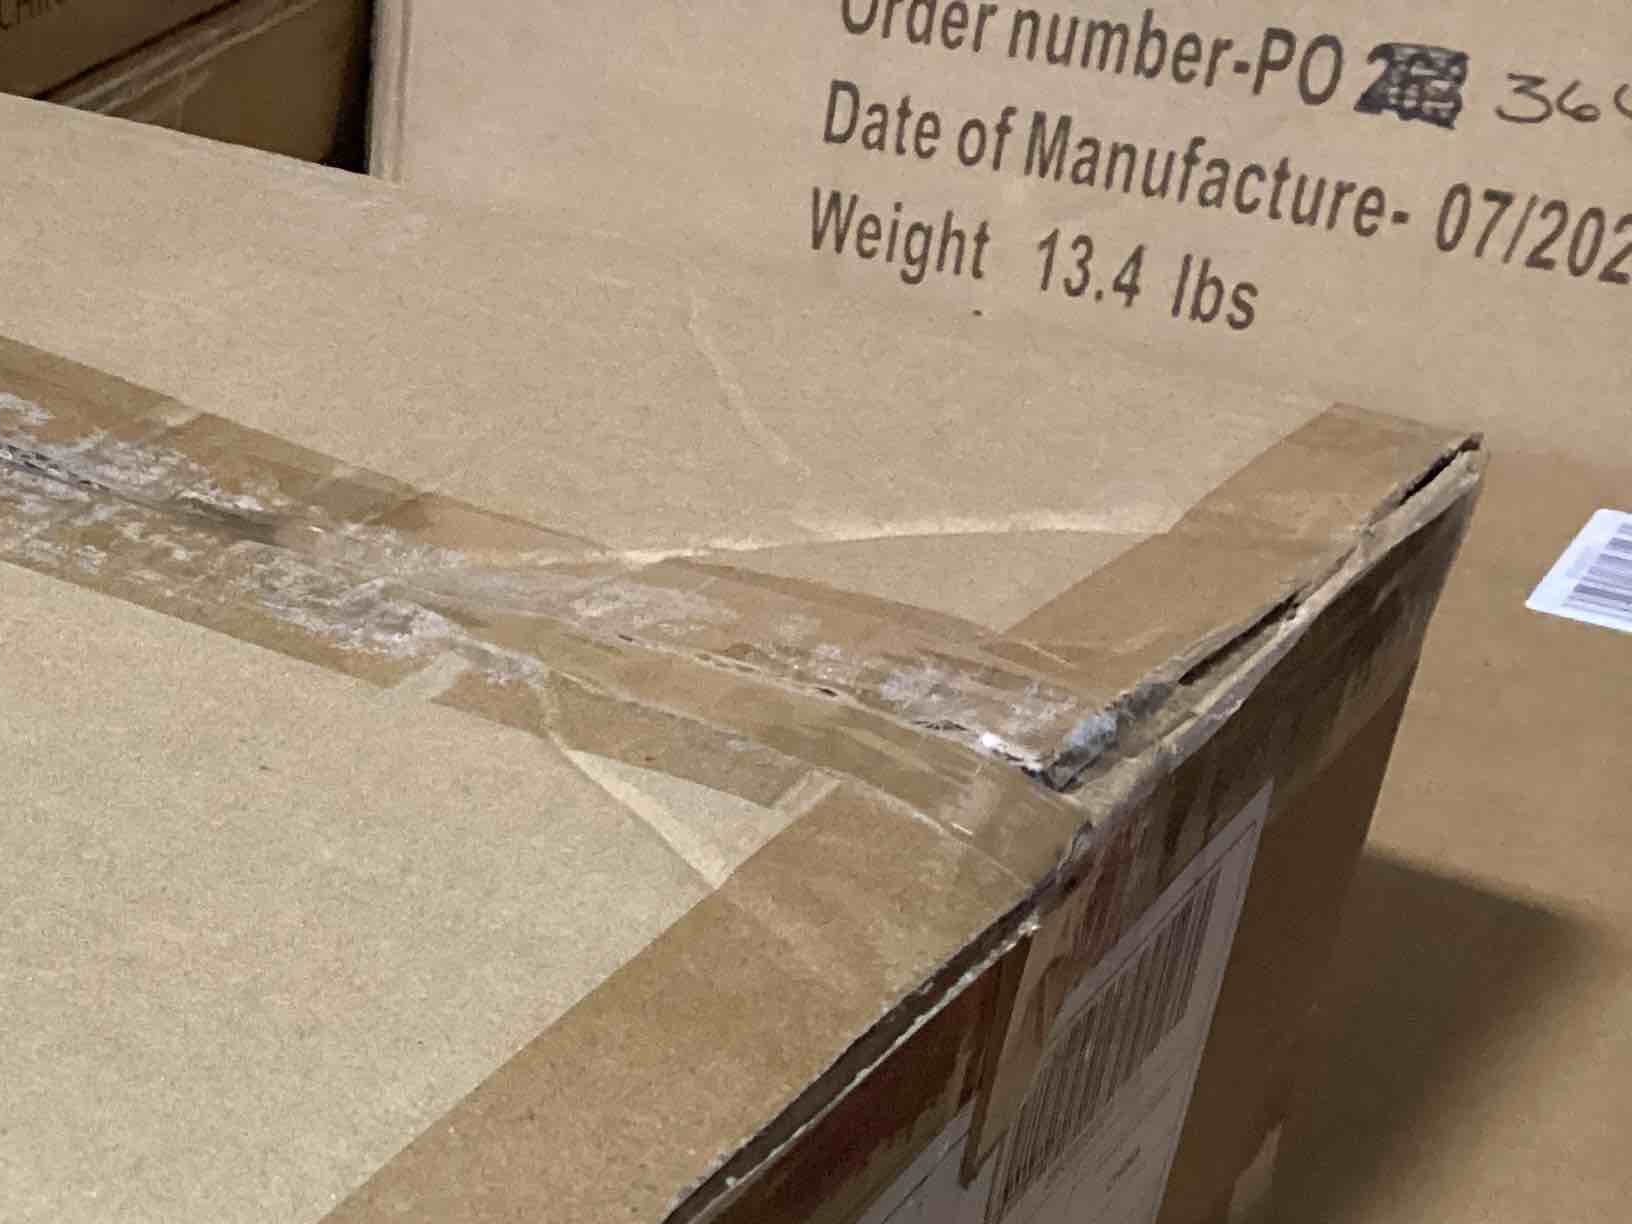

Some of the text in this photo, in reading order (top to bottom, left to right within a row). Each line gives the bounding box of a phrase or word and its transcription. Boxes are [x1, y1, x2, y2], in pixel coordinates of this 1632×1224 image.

[823, 79, 942, 160] Date
[956, 105, 1018, 172] of
[1023, 110, 1410, 238] Manufacture-
[810, 186, 1258, 331] Weight 13.4 lbs
